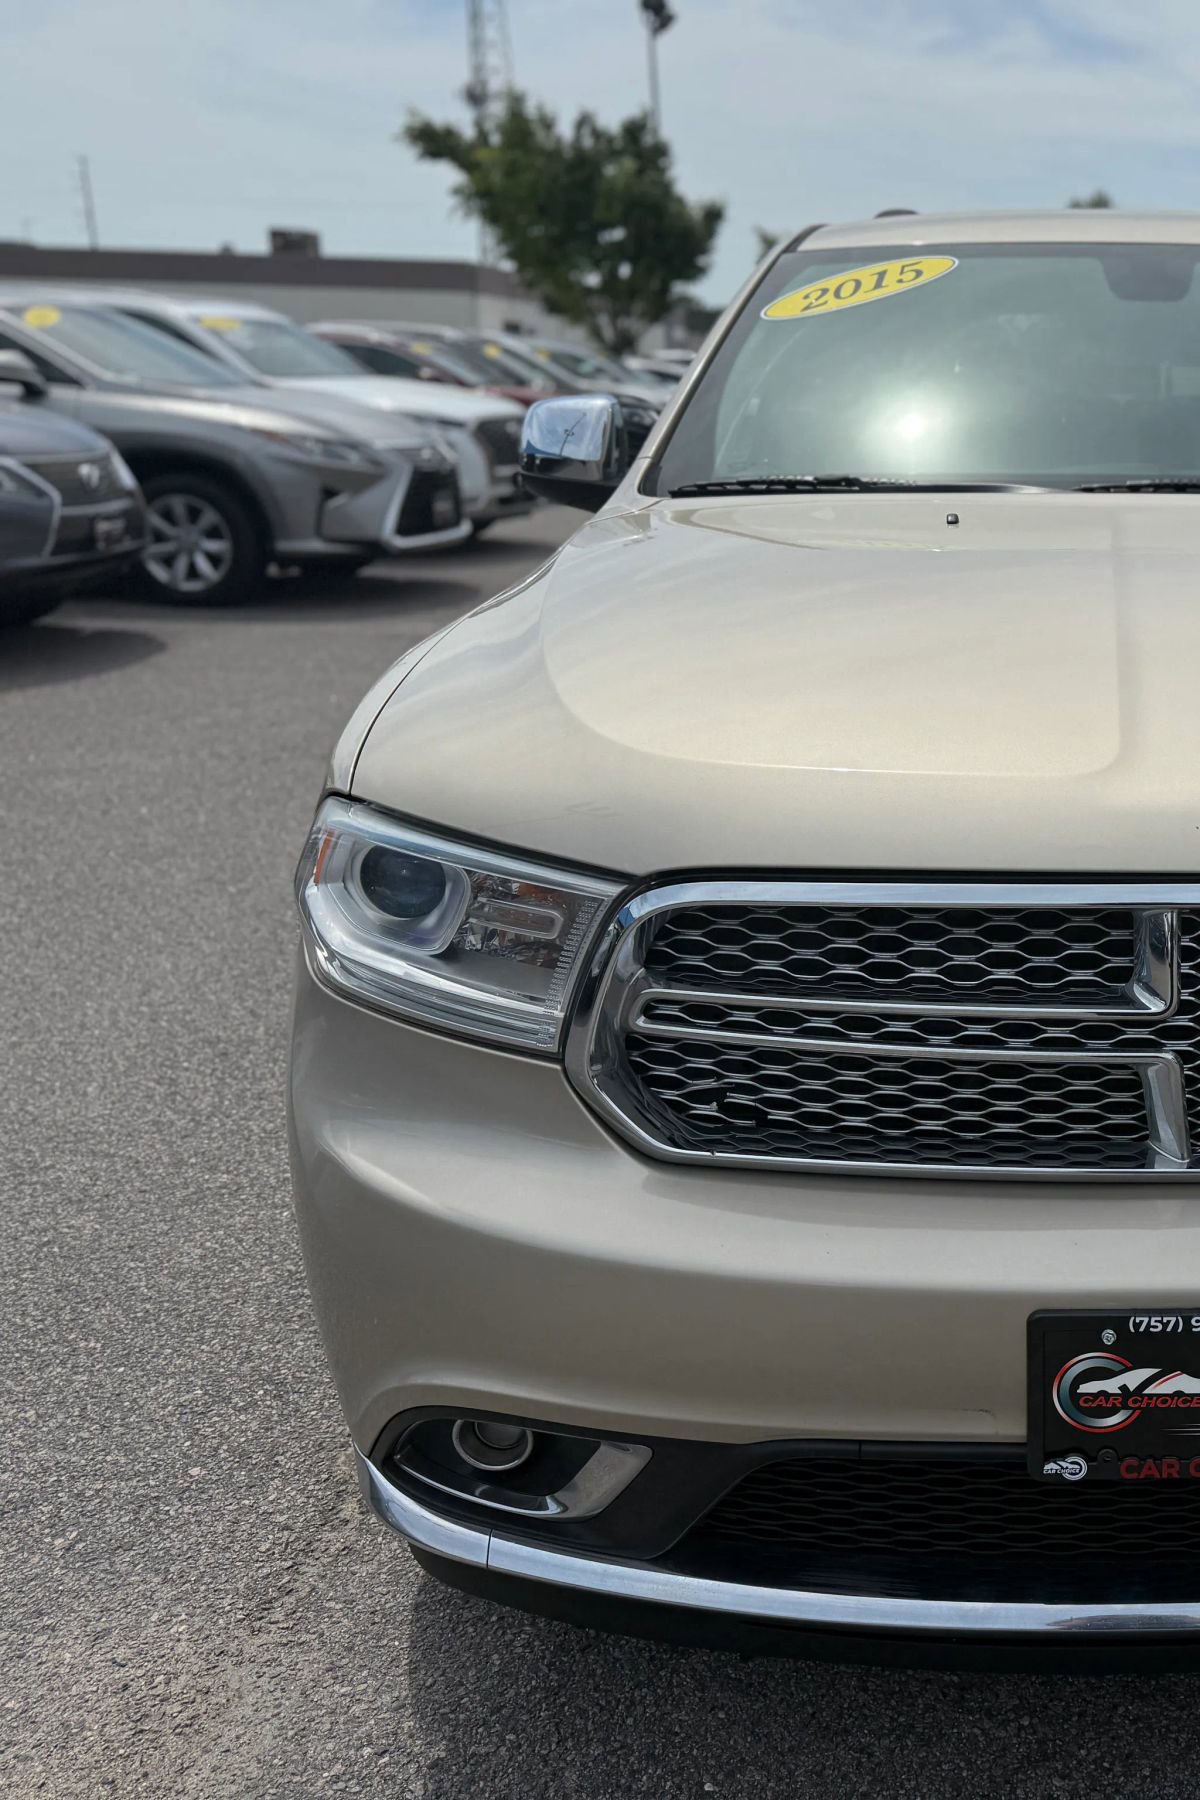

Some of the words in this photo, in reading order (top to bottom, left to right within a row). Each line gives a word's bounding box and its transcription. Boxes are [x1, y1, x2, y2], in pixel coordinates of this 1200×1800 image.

[800, 260, 924, 313] 2015
[1128, 1316, 1184, 1333] (757)
[1079, 1396, 1123, 1408] CAR
[1119, 1457, 1181, 1480] CAR
